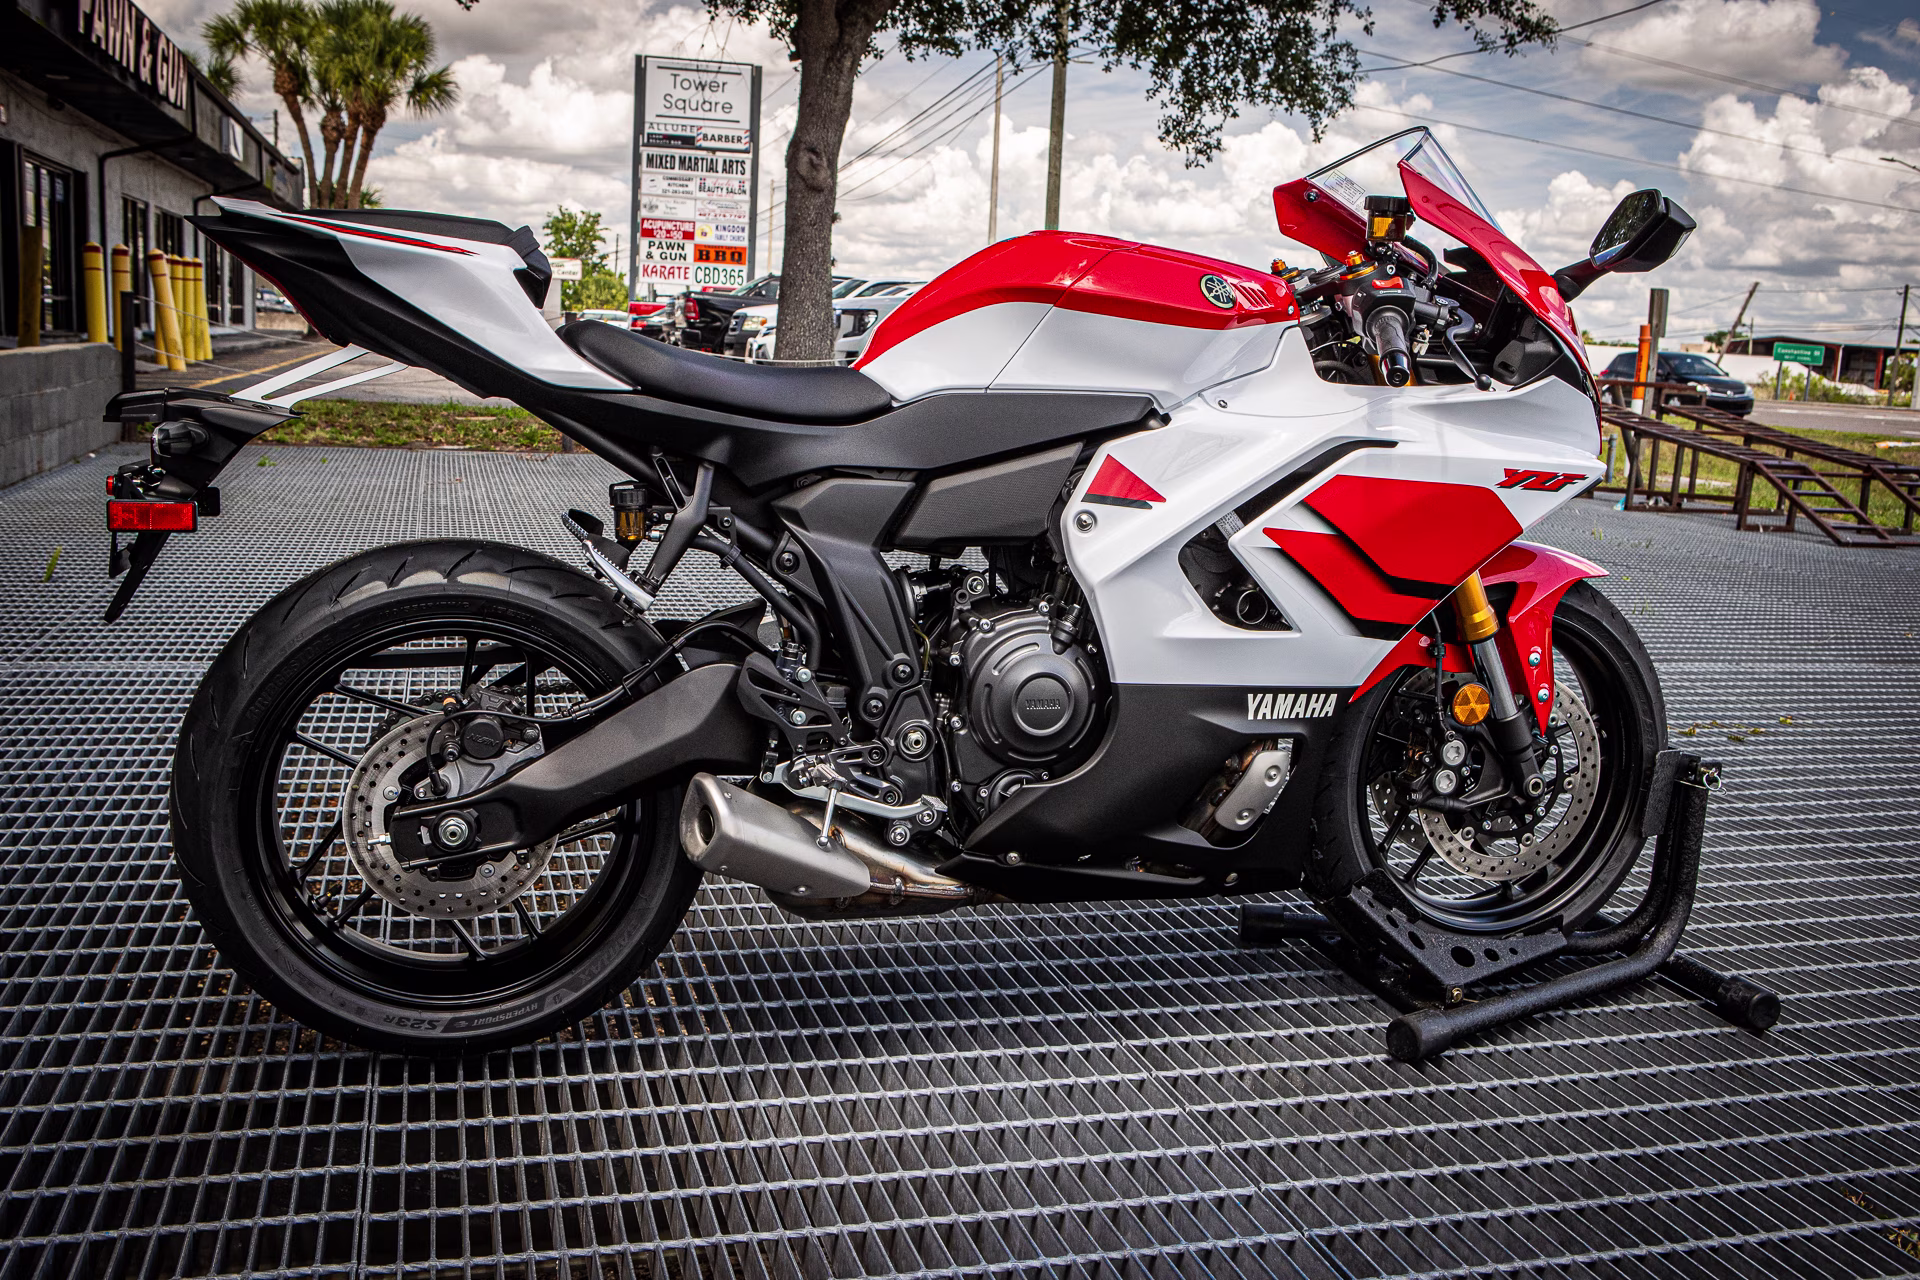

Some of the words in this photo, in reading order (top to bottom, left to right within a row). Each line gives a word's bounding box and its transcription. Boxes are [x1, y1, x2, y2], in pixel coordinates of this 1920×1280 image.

[139, 17, 152, 85] &
[156, 33, 188, 110] GUN
[670, 73, 728, 93] Tower
[663, 93, 733, 114] Square
[648, 122, 696, 134] ALLURE
[702, 133, 743, 144] BARBER
[646, 153, 676, 170] MIXED
[678, 155, 719, 173] MARTIAL
[721, 159, 746, 175] ARTS
[698, 184, 723, 193] BEAUTY
[726, 187, 747, 195] SALON
[642, 219, 695, 232] ACUPUNCTURE
[715, 224, 746, 233] KINGDOM
[648, 240, 685, 251] PAWN
[645, 250, 654, 260] &
[660, 251, 687, 261] GUN
[697, 248, 743, 264] BBQ
[642, 264, 690, 280] KARATE
[695, 266, 744, 286] CBD365
[1247, 693, 1338, 720] YAMAHA
[385, 1014, 441, 1031] S23R
[471, 1002, 539, 1027] HYPERSPORT
